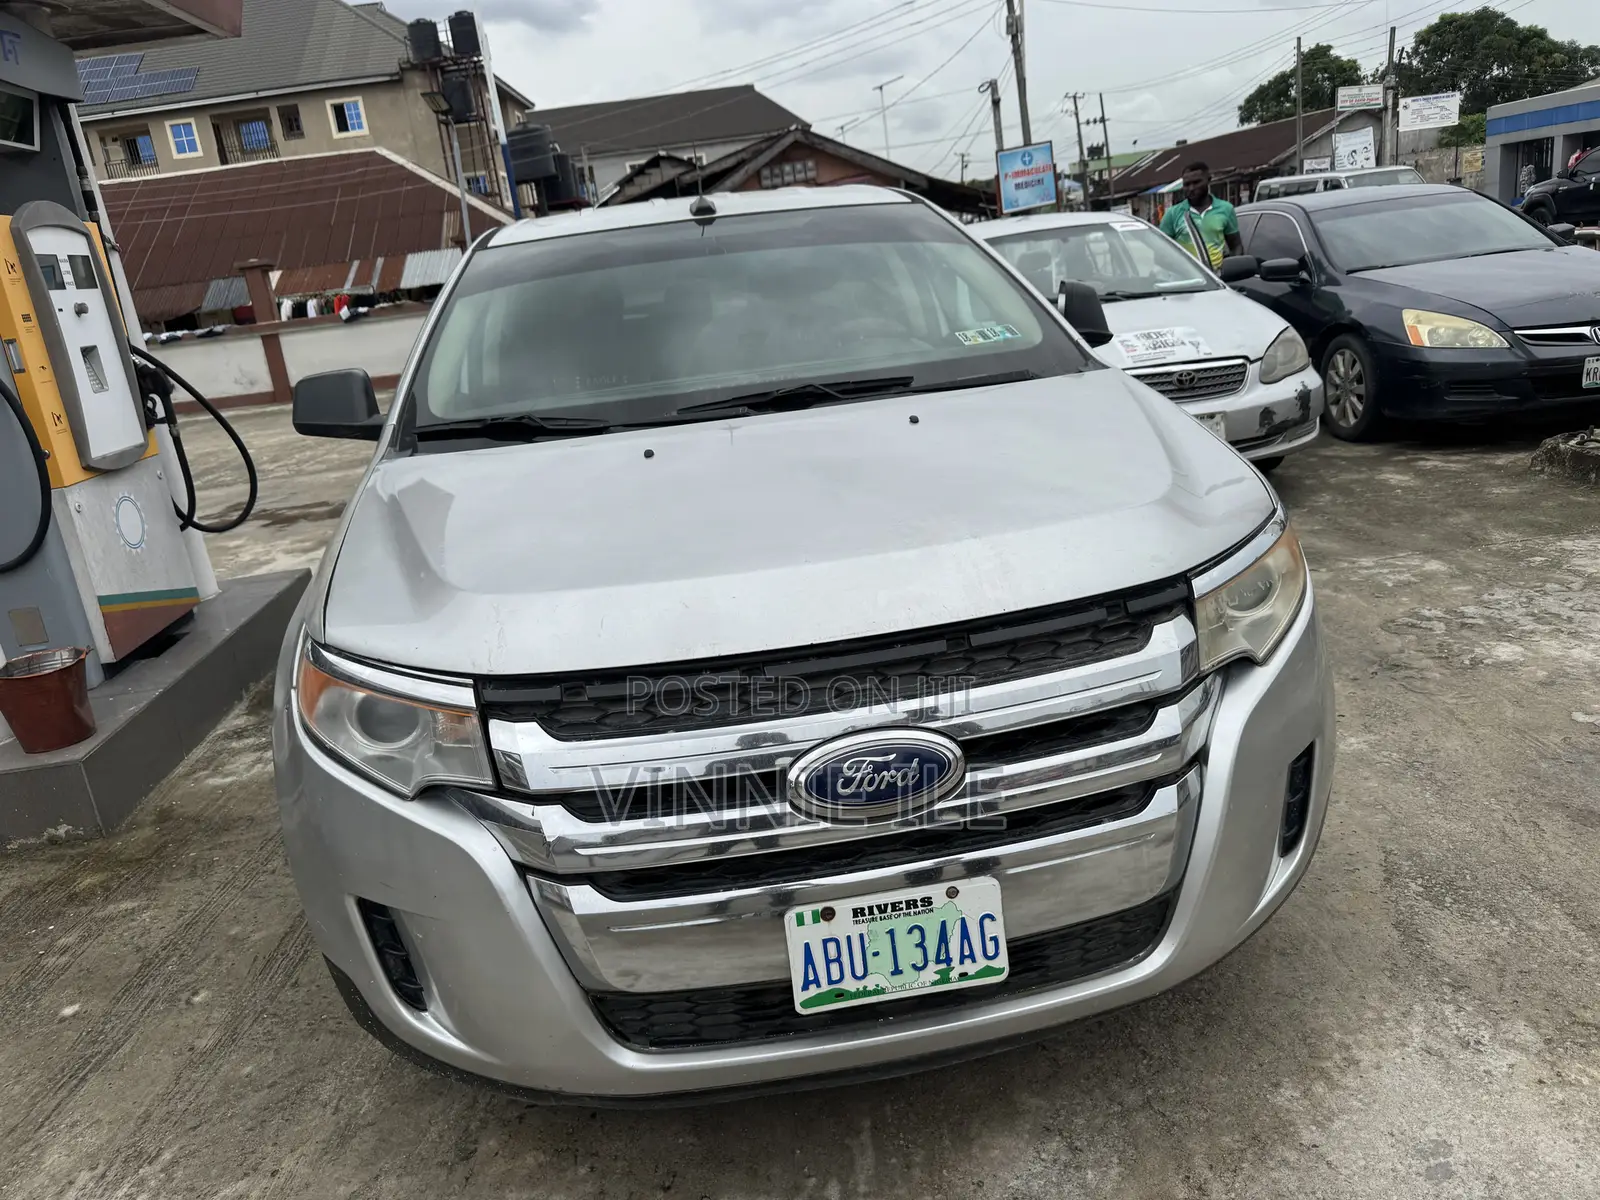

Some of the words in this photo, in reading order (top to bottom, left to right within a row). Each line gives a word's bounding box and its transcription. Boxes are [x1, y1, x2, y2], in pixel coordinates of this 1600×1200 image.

[1585, 367, 1600, 382] KR
[836, 753, 920, 796] Ford
[851, 896, 934, 919] RIVERS
[852, 916, 879, 926] TREASURE
[880, 914, 893, 922] BASE
[912, 908, 934, 917] NATION
[801, 913, 1000, 992] ABU-134AG
